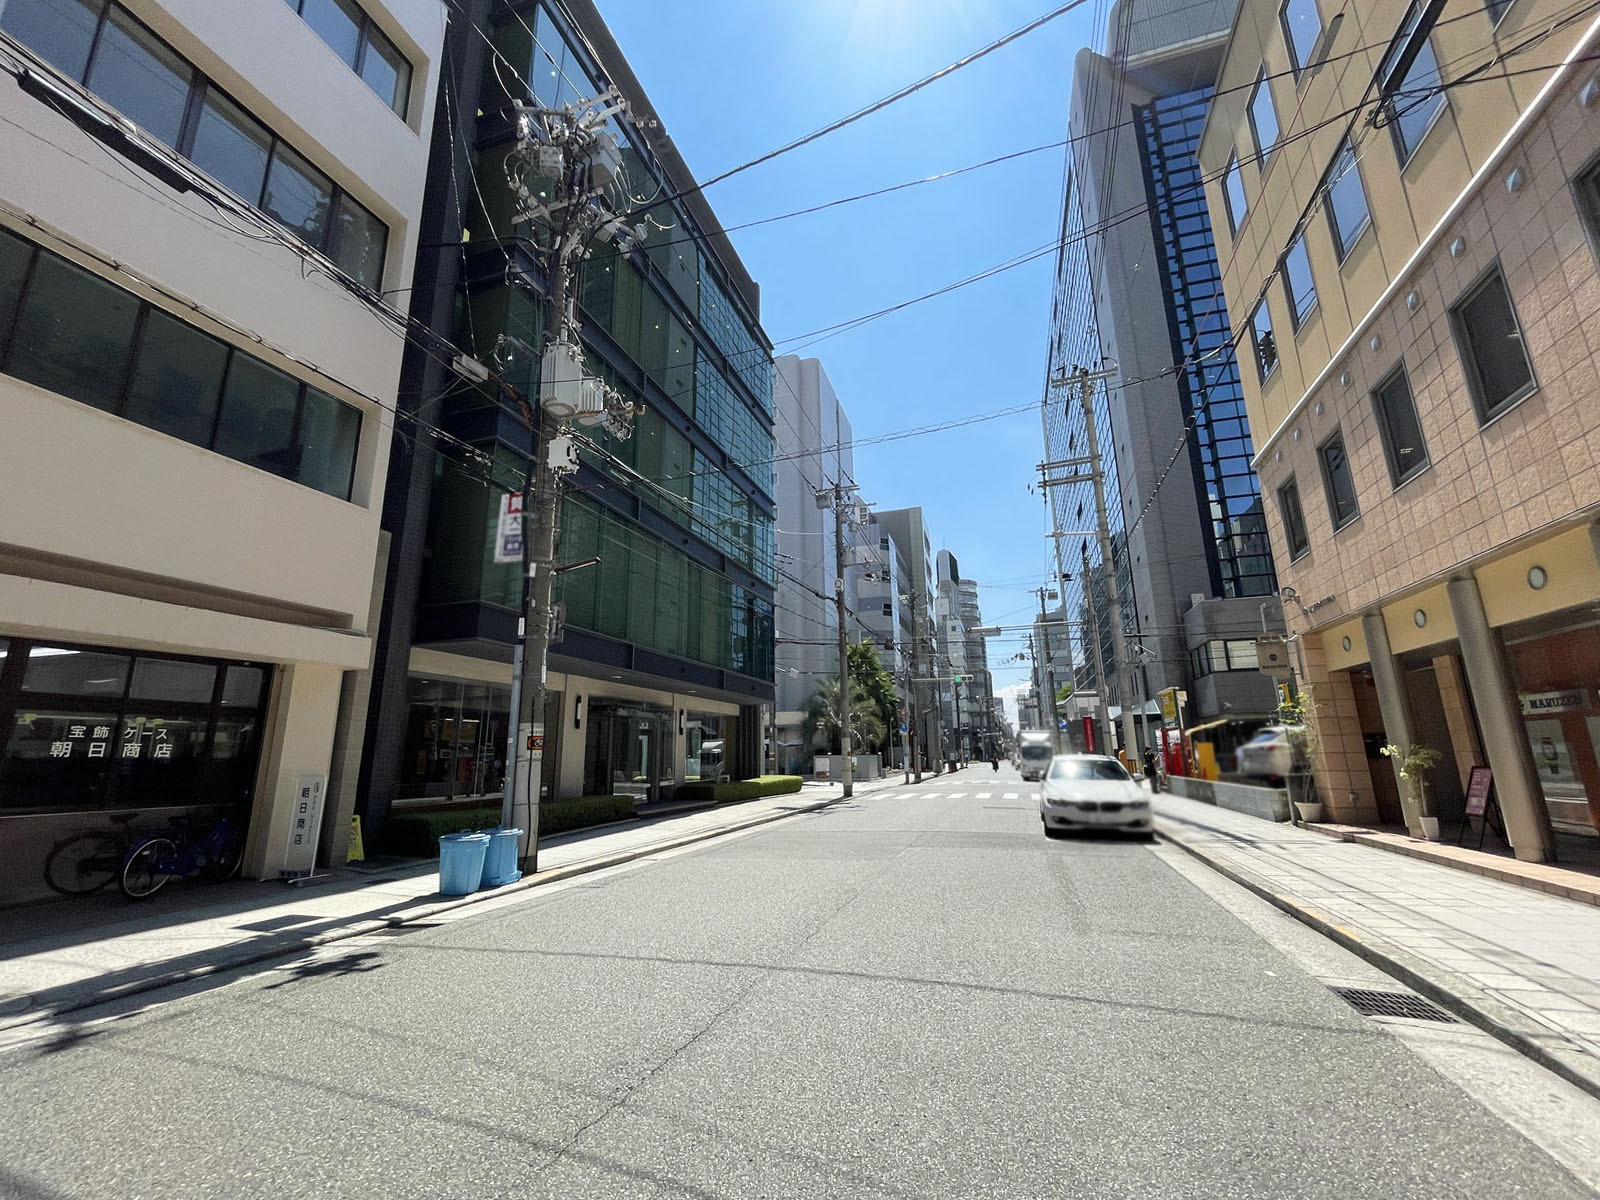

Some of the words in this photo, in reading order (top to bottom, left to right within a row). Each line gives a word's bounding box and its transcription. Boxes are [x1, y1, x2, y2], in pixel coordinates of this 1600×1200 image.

[1529, 696, 1581, 709] MARUZEN
[50, 741, 173, 758] 朝日商店
